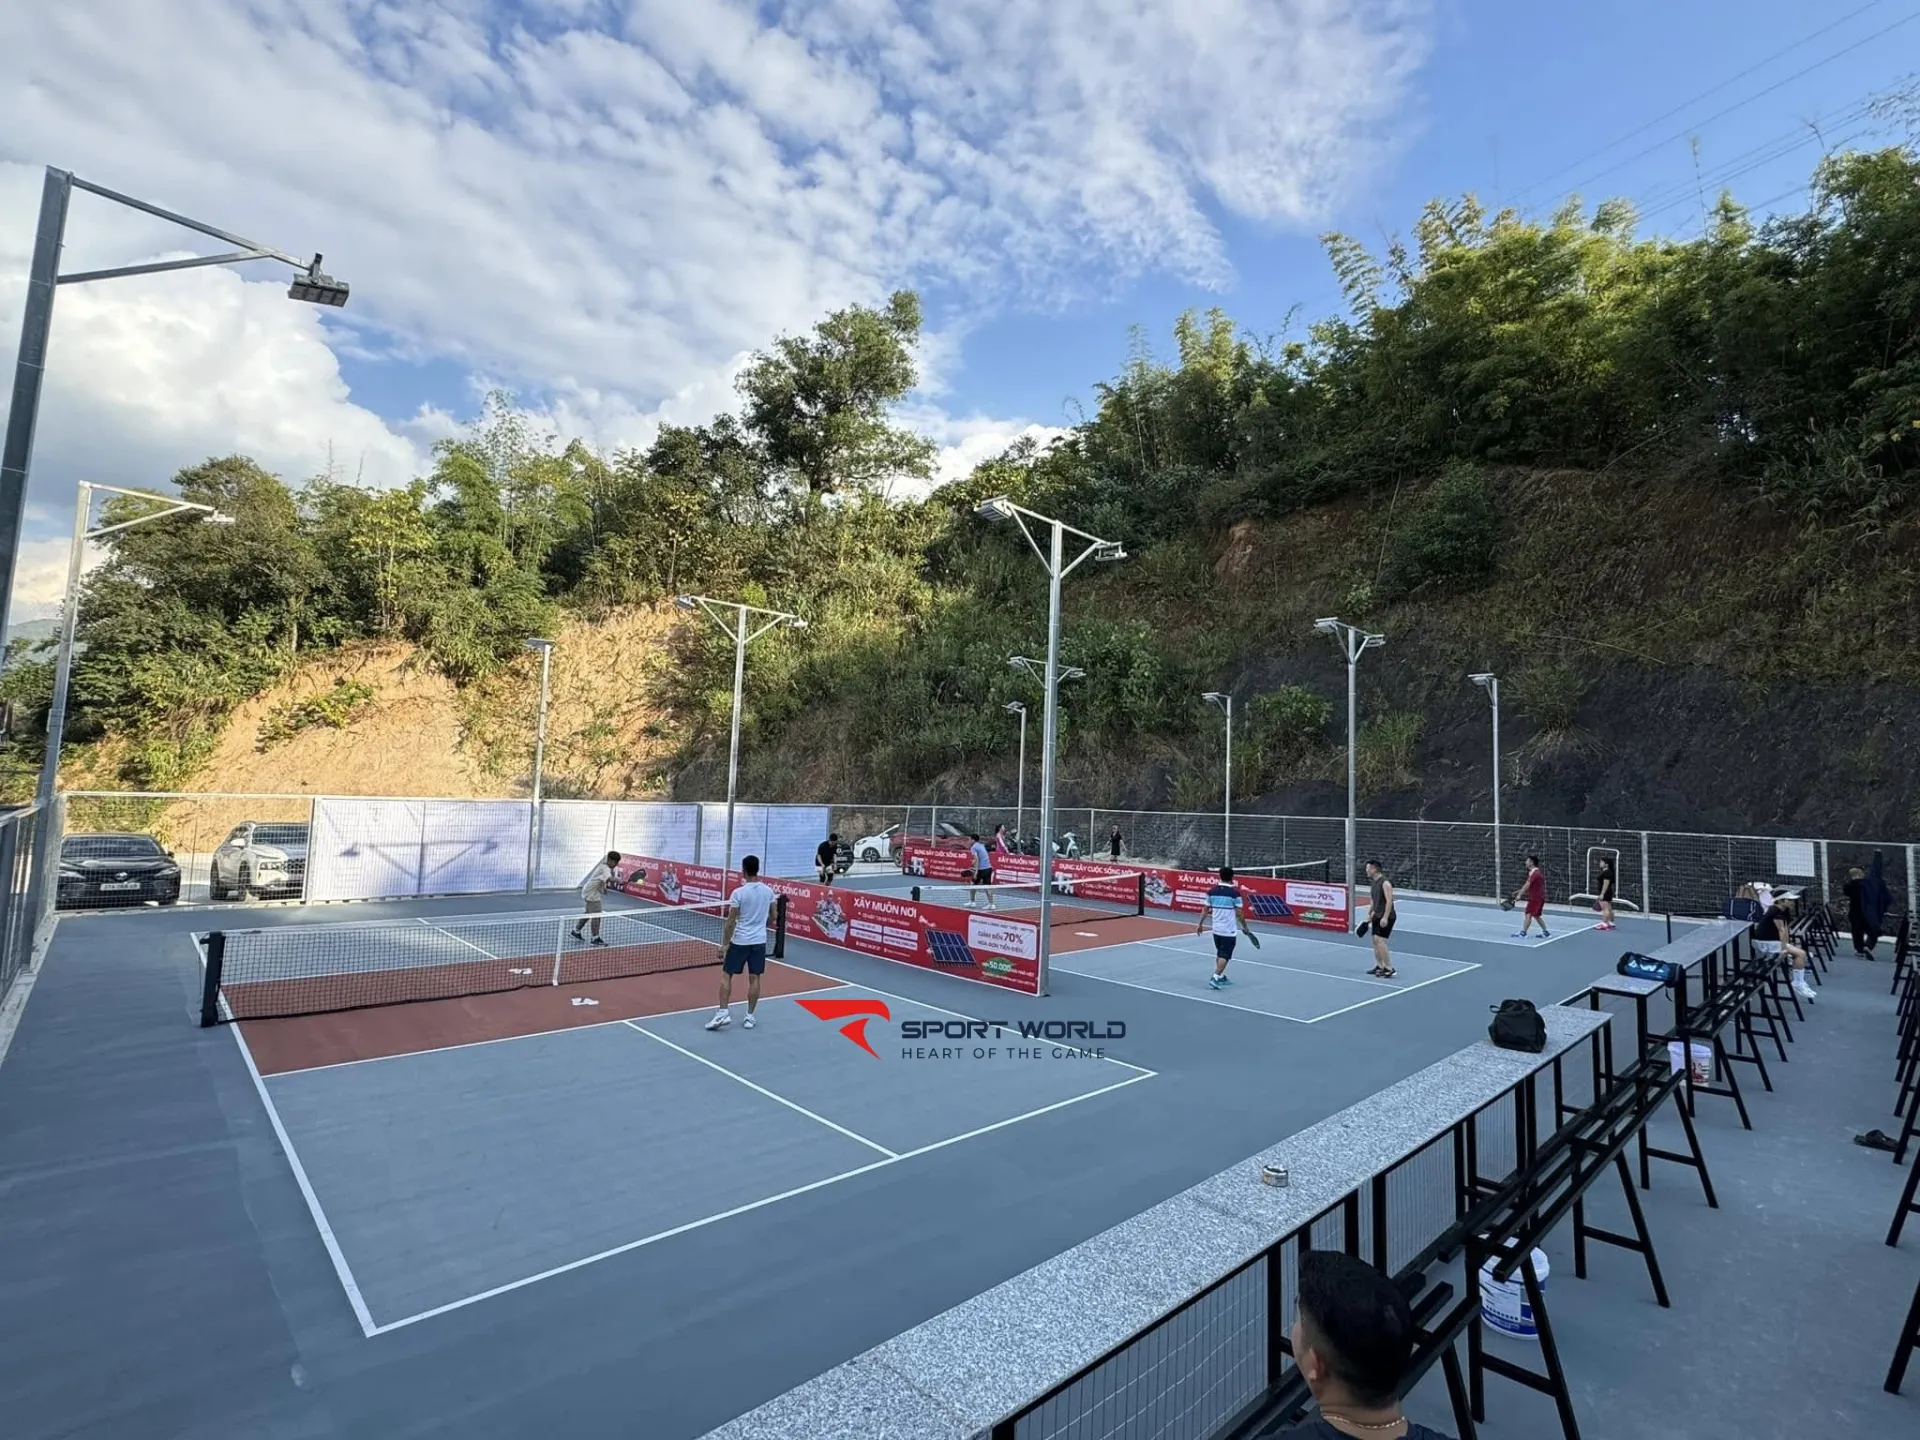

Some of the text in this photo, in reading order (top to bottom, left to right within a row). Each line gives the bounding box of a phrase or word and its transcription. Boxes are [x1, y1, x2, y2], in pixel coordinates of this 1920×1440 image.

[1178, 873, 1195, 883] XÂY
[1317, 892, 1334, 900] 70%
[853, 896, 917, 918] XÂY MUÔN NƠI
[978, 930, 1023, 945] GIẢM ĐẾN 70%
[1000, 943, 1011, 951] TIỀN
